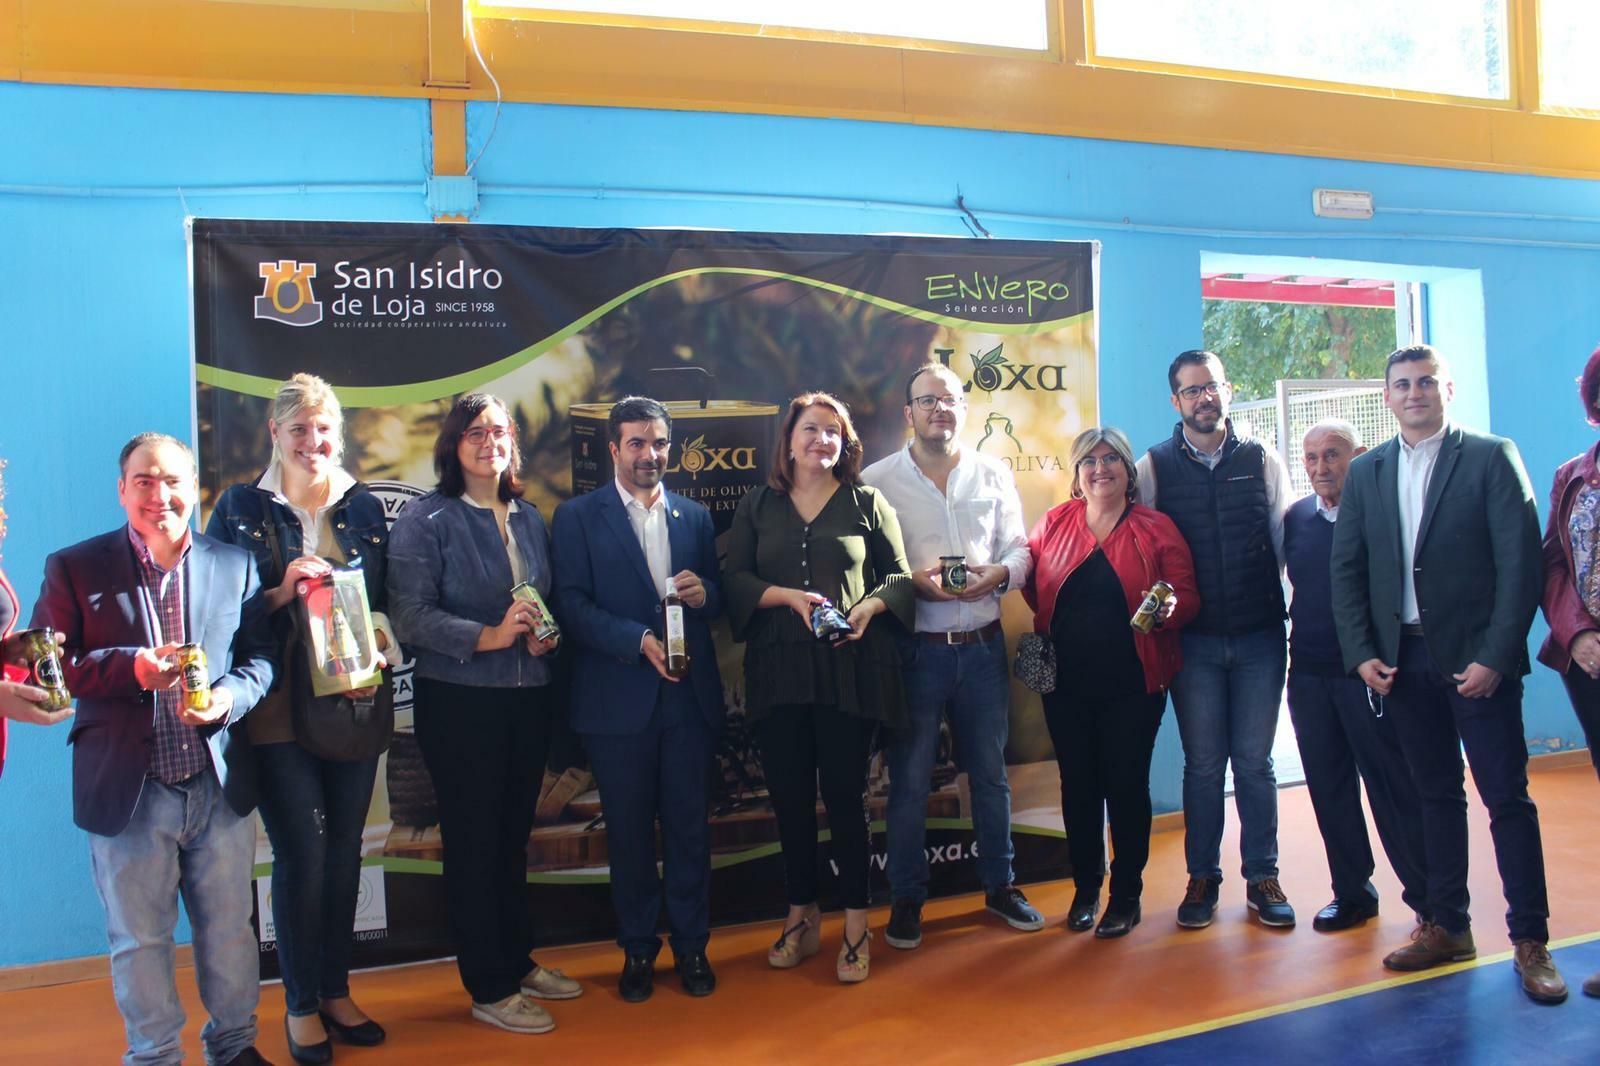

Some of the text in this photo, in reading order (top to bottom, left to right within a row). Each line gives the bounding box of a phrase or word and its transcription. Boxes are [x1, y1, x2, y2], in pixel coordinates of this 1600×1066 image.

[334, 260, 503, 290] San Isidro
[331, 293, 425, 321] de Loja
[435, 302, 495, 313] SINCE 1958
[944, 303, 1024, 314] Selección
[333, 321, 508, 329] sociedad cooperativa andaluza
[700, 487, 717, 497] DE
[720, 484, 757, 496] OLIV
[715, 500, 738, 511] EXT
